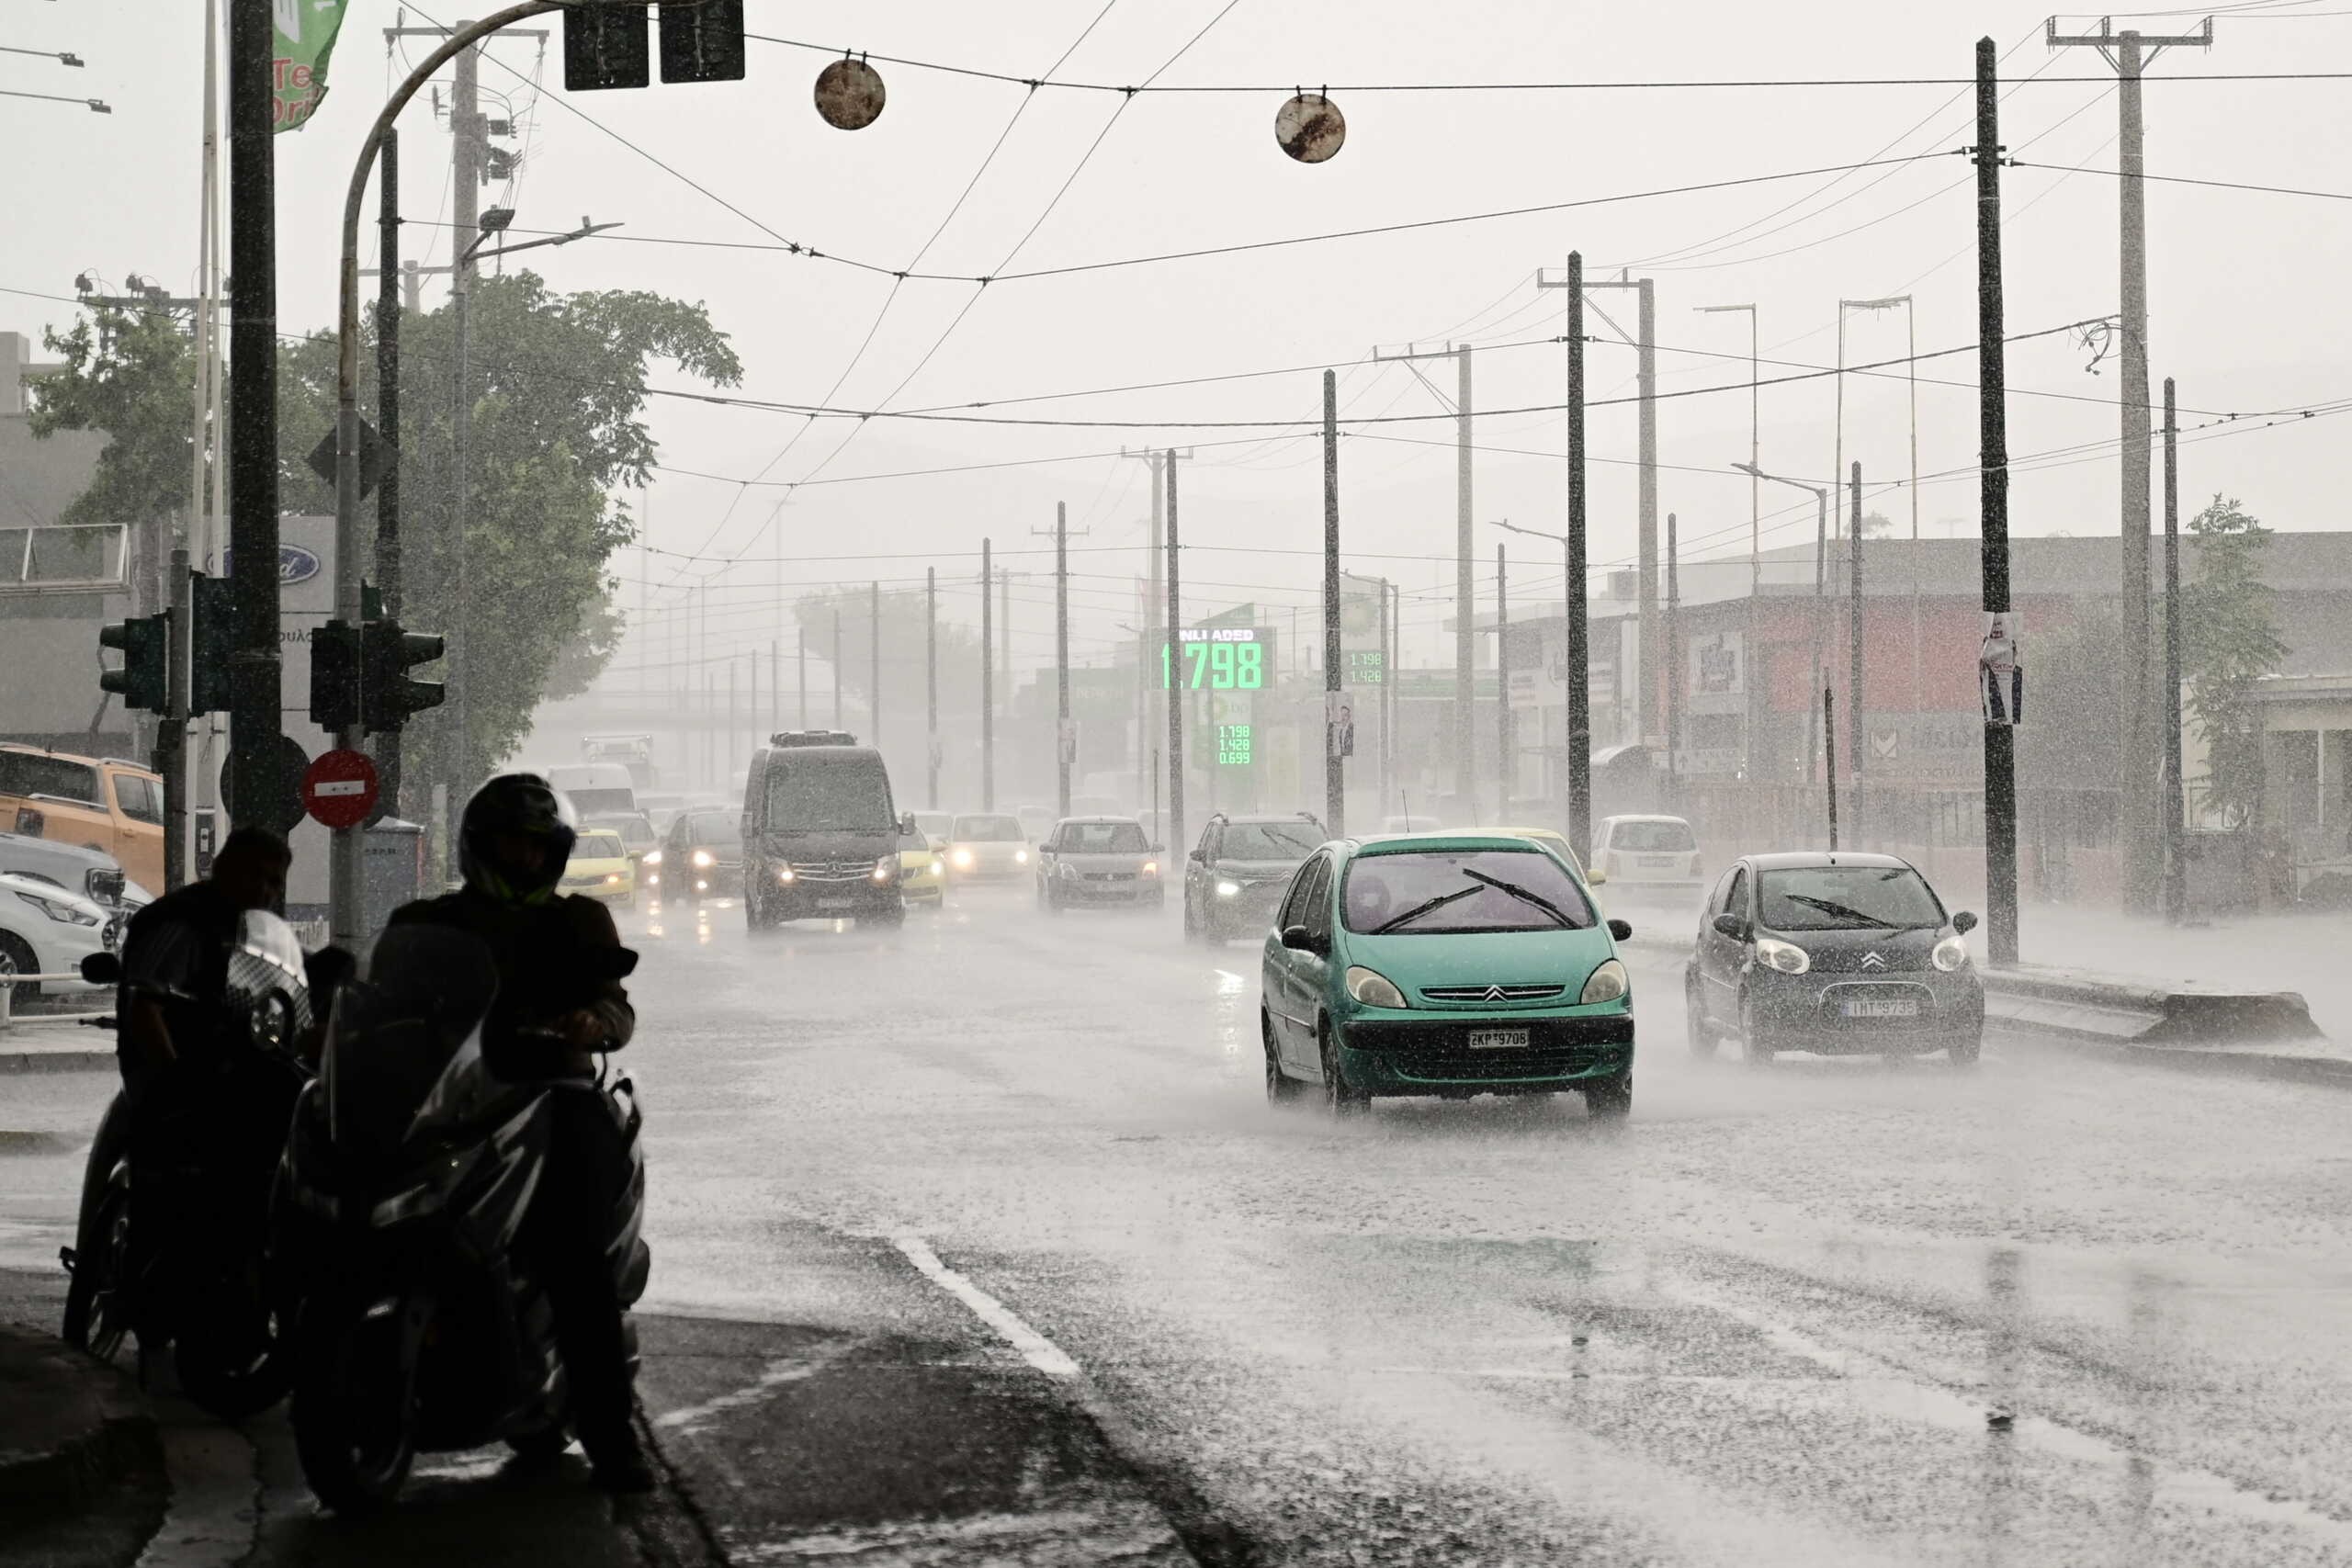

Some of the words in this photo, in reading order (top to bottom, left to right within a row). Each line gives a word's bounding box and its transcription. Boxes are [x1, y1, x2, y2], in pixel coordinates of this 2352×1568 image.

[1219, 725, 1250, 738] 1.798
[1219, 739, 1250, 751] 1.428
[1219, 751, 1250, 764] 0.699
